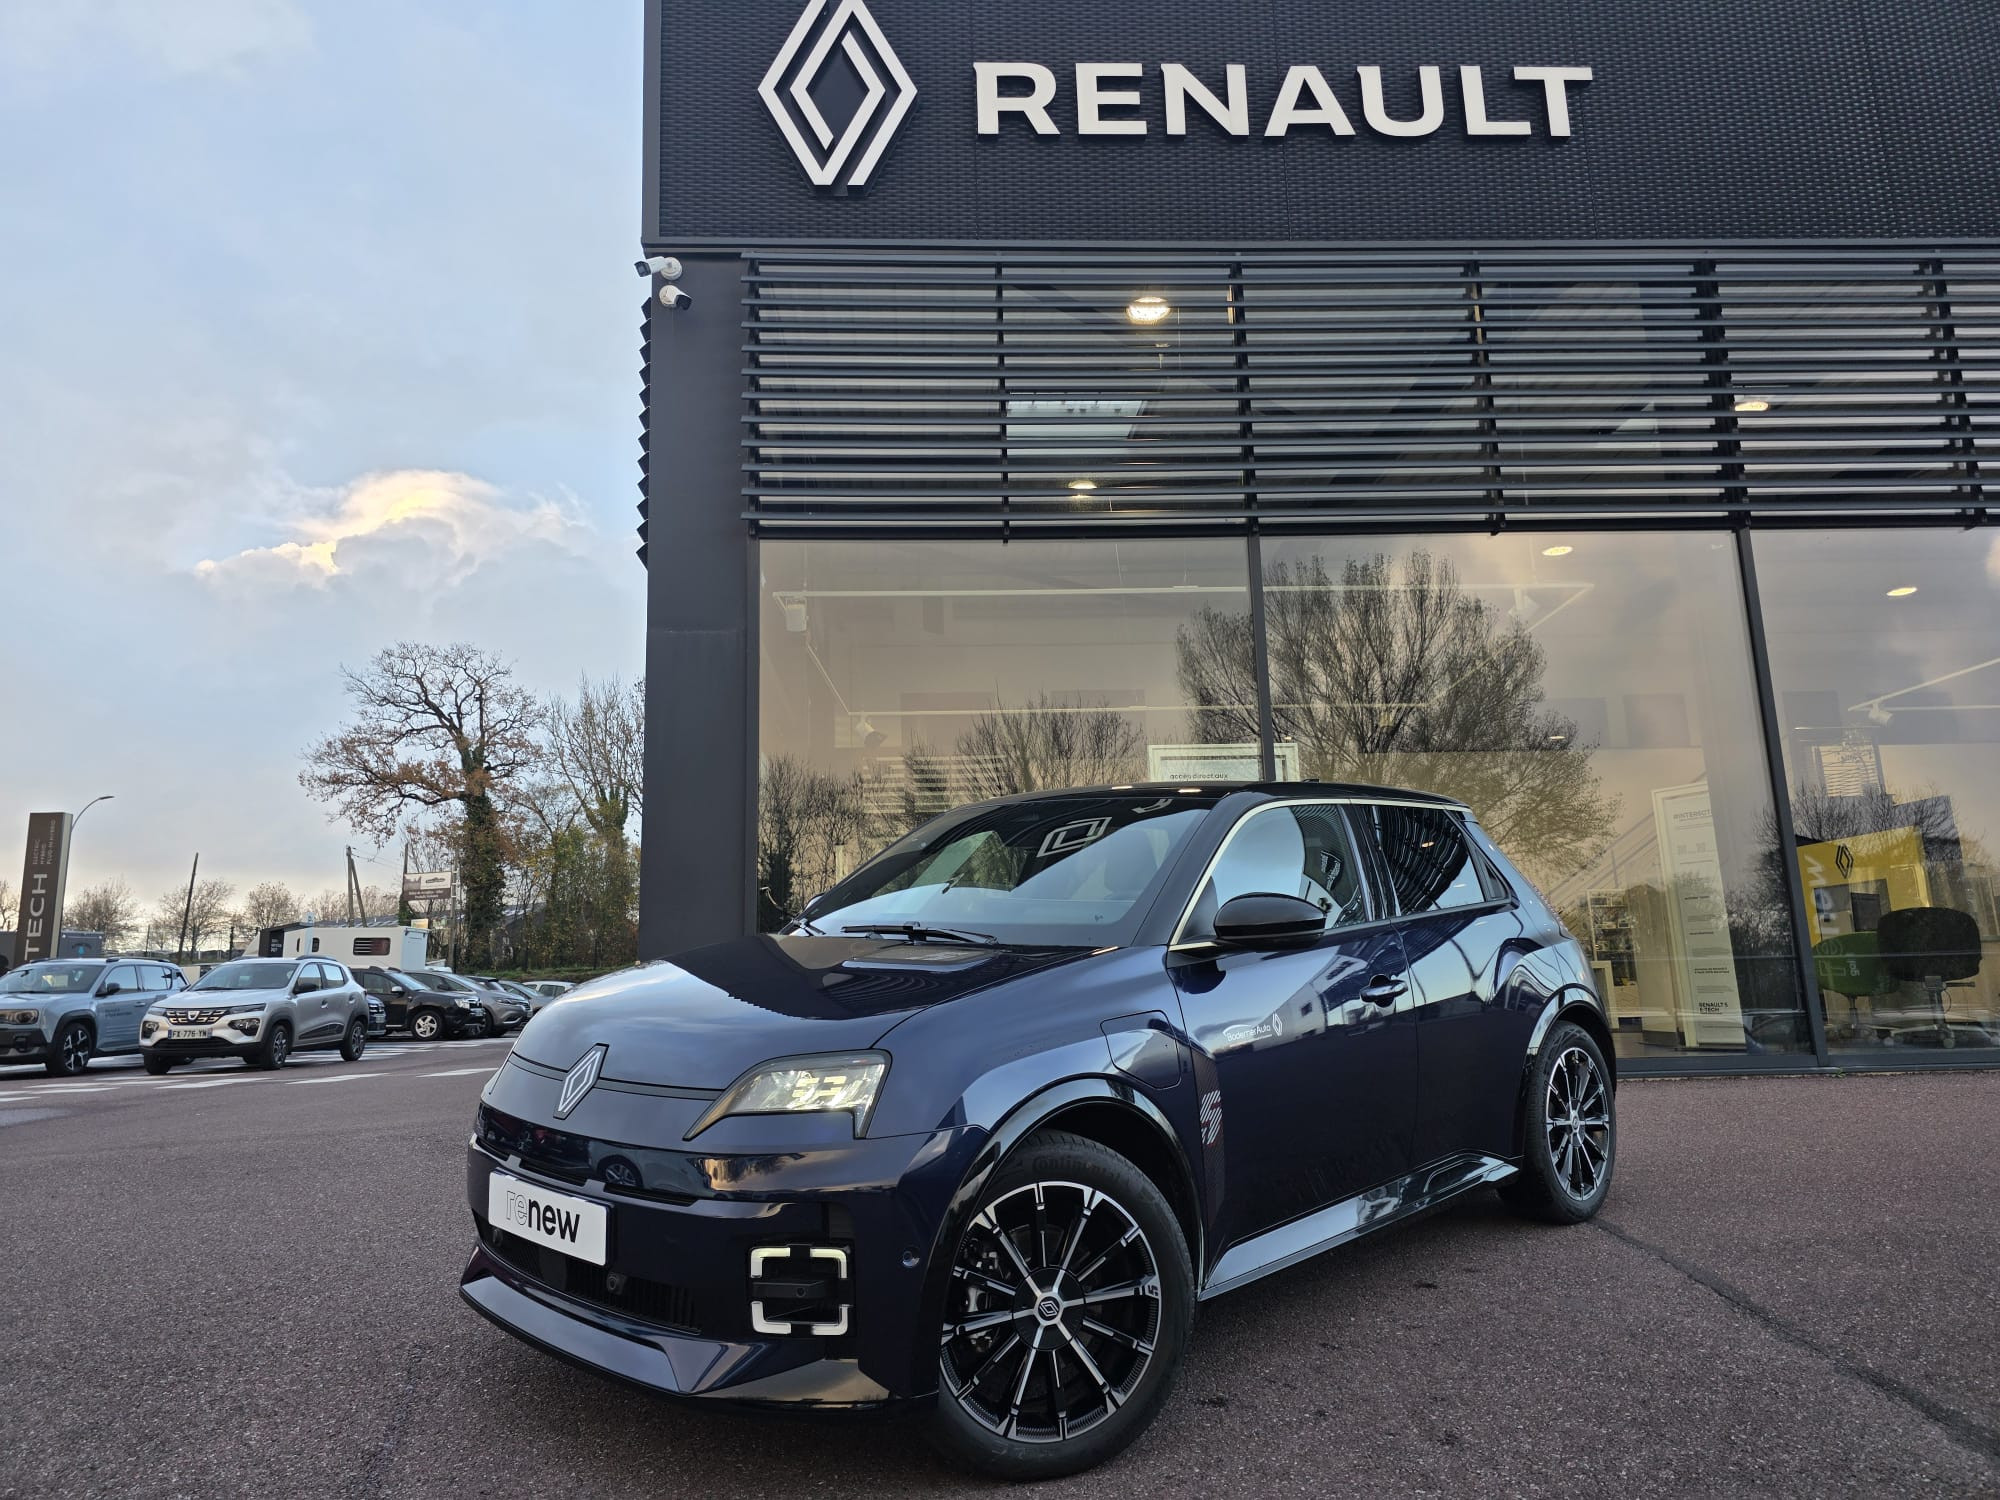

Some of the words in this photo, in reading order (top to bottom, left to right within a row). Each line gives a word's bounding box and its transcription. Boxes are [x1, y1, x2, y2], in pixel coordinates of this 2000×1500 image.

[972, 61, 1593, 137] RENAULT
[24, 873, 48, 961] TECH
[506, 1190, 580, 1243] renew
